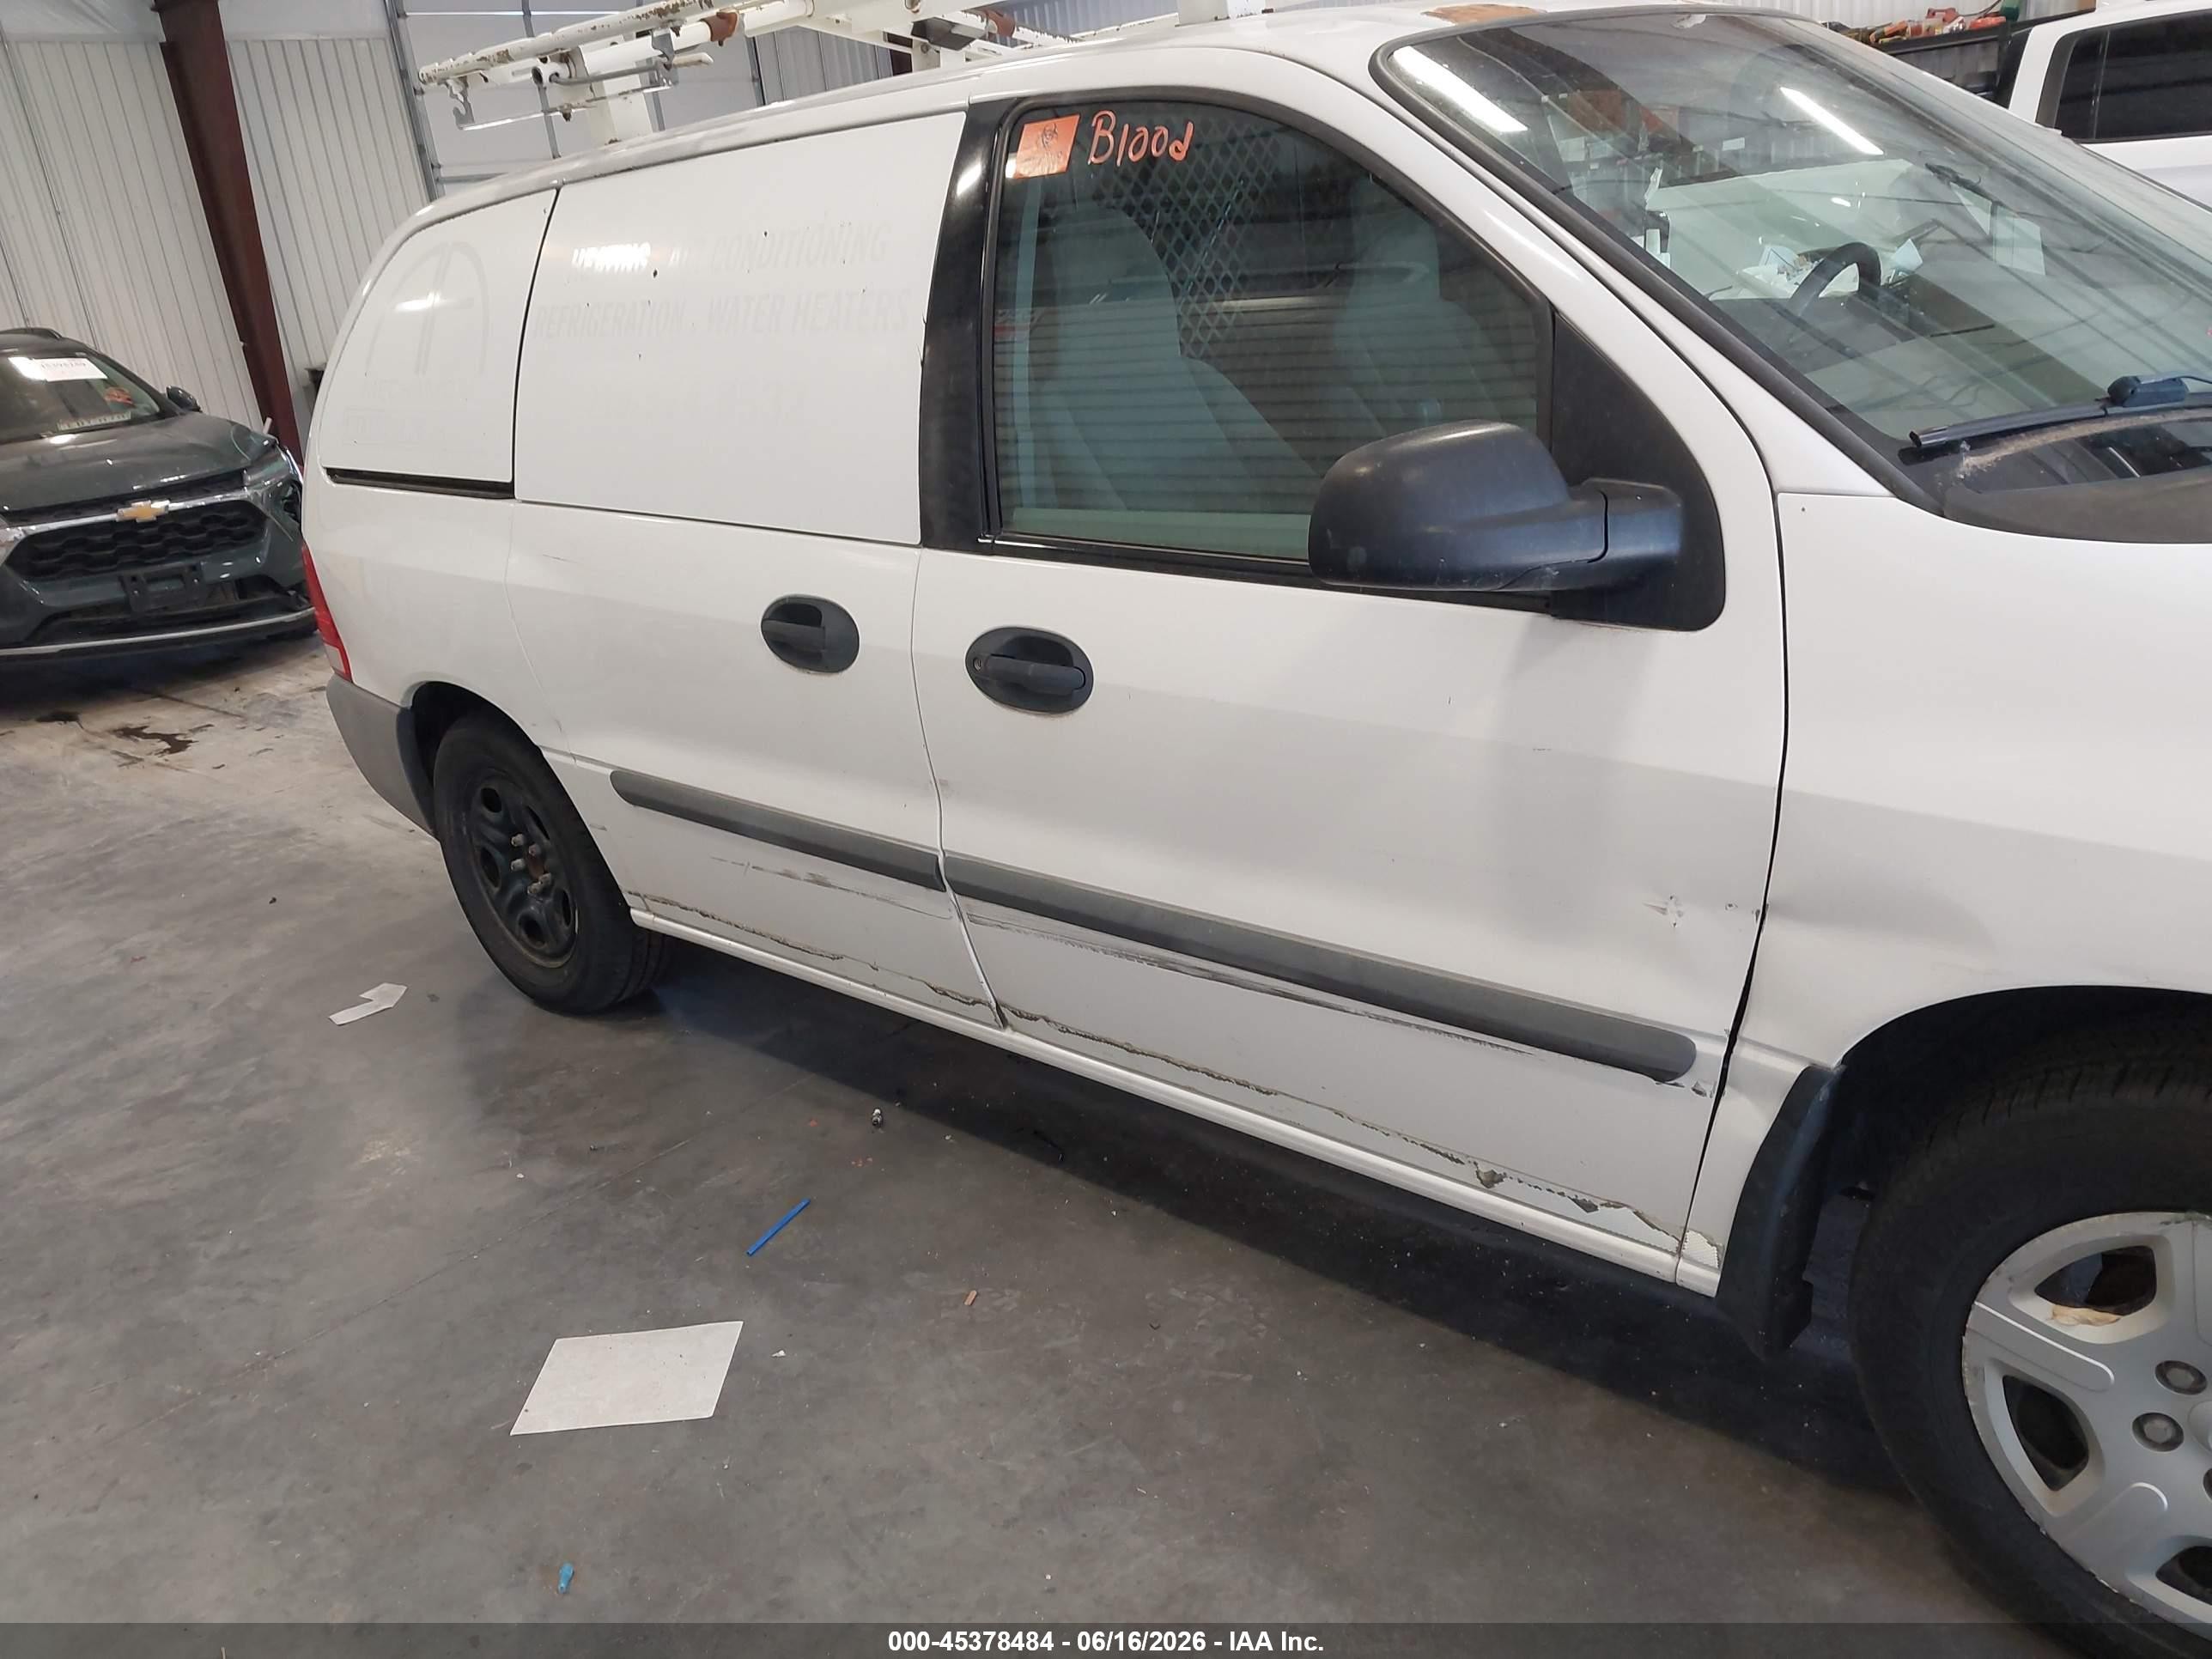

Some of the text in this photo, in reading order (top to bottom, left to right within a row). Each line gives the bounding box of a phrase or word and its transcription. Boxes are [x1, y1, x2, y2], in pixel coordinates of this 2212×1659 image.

[1088, 110, 1194, 167] Blood
[710, 220, 892, 272] CONDITIONING
[706, 293, 785, 337] WATER
[791, 288, 913, 335] HEATERS
